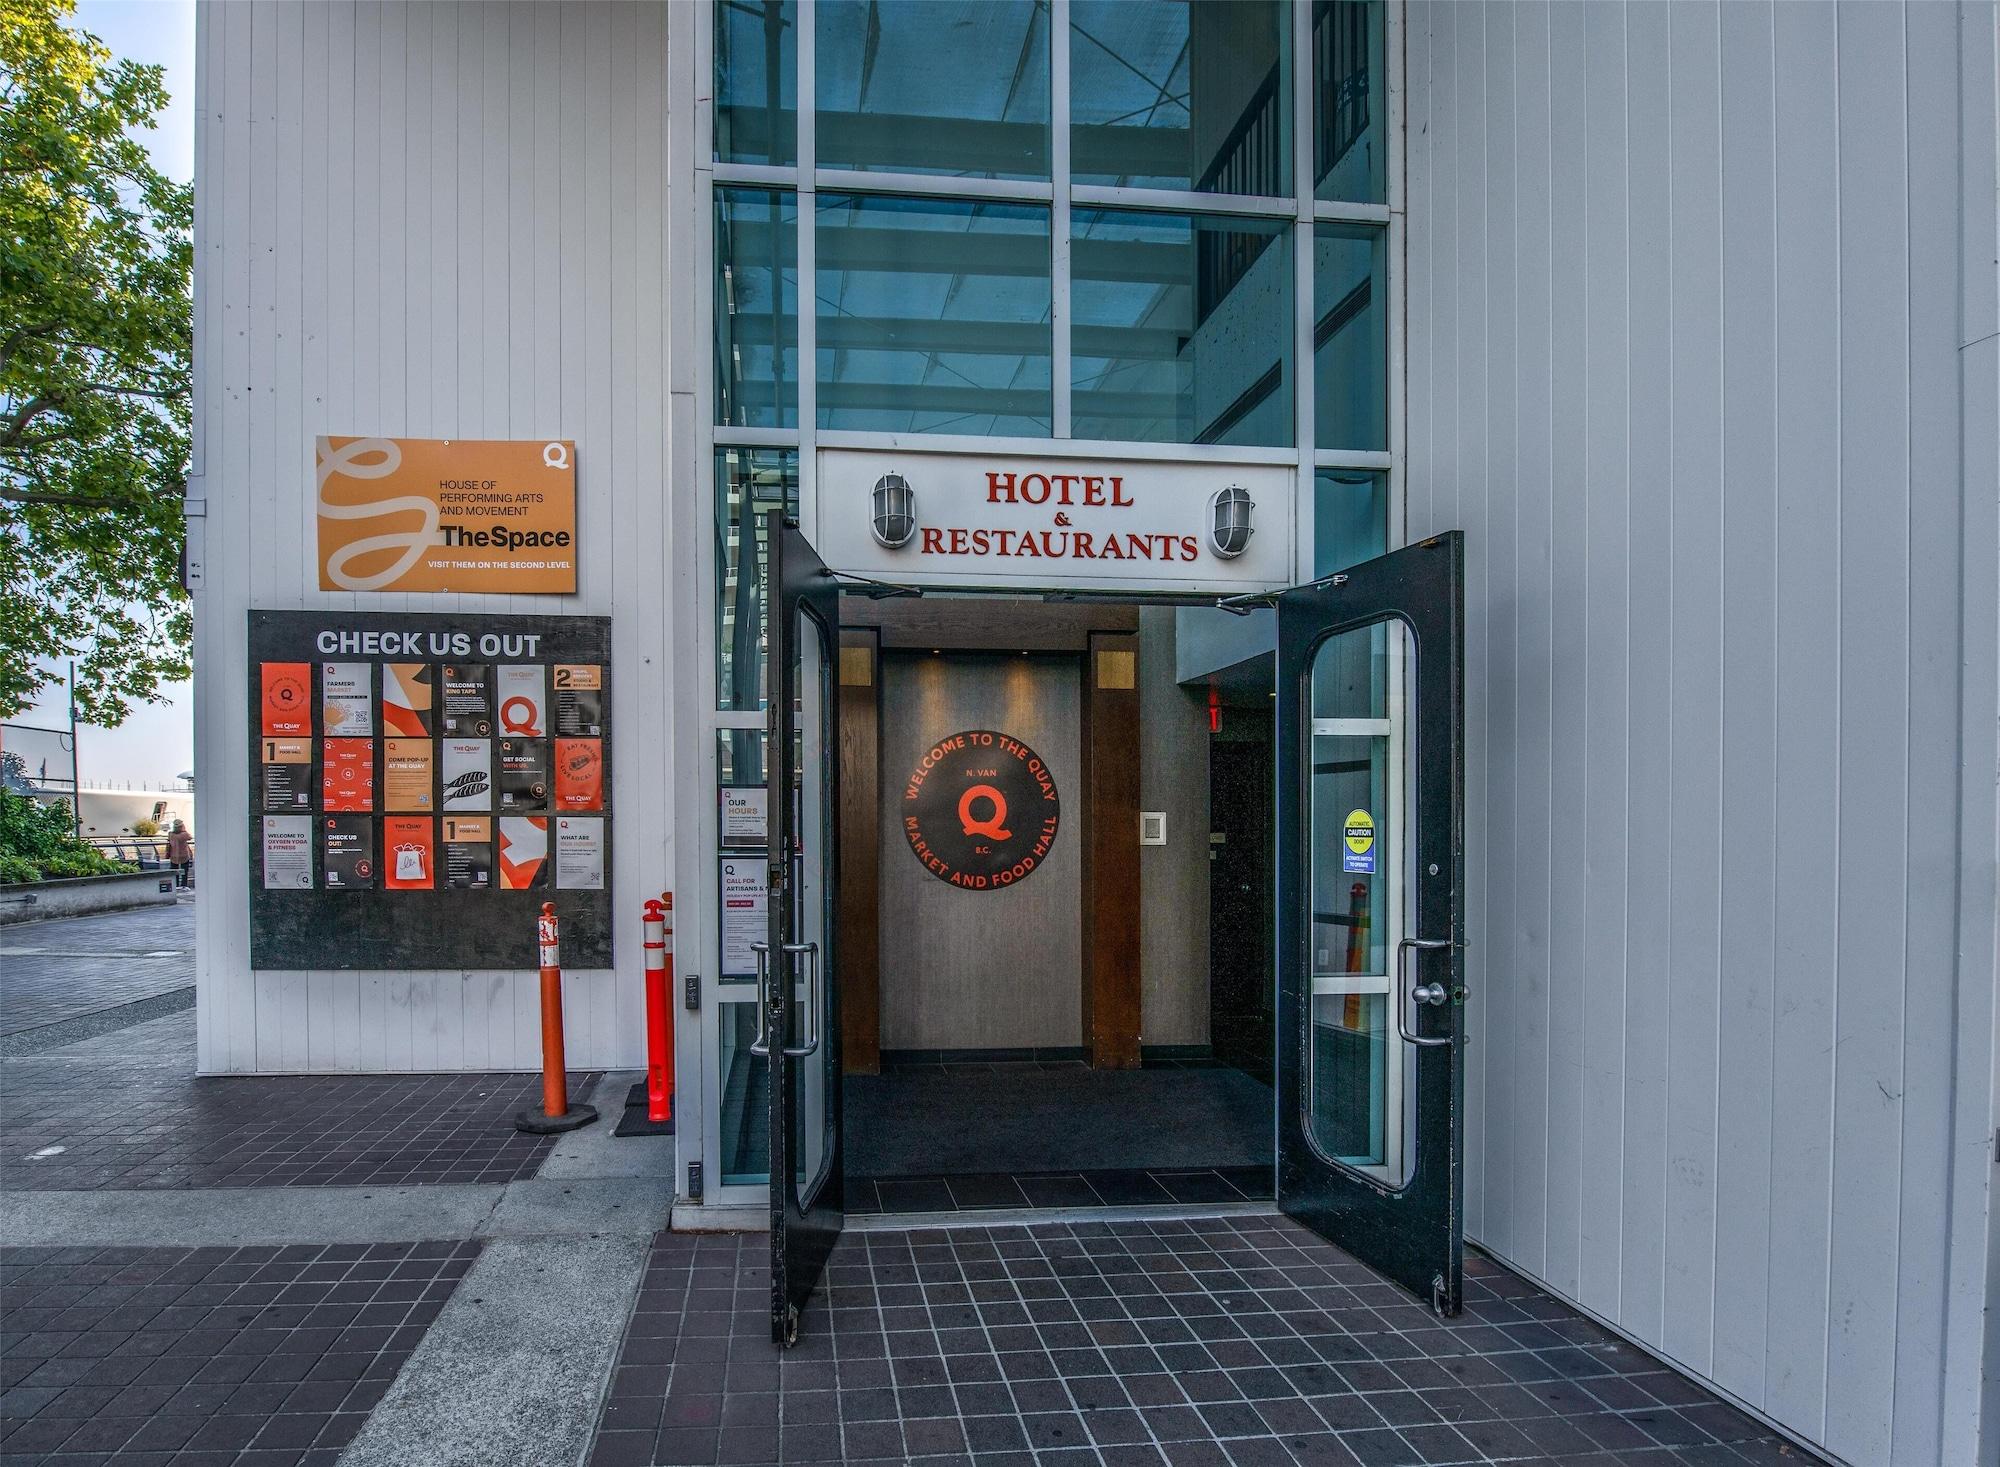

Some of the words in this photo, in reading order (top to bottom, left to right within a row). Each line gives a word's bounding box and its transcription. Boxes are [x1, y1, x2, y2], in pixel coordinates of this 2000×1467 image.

[543, 442, 569, 470] Q
[440, 480, 478, 490] HOUSE
[481, 480, 497, 490] OF
[985, 472, 1134, 507] HOTEL
[440, 493, 513, 503] PERFORMING
[515, 493, 544, 503] ARTS
[440, 506, 463, 516] AND
[466, 506, 528, 516] MOVEMENT
[1053, 511, 1072, 527] &
[440, 525, 570, 551] TheSpace
[920, 527, 1198, 562] RESTAURANTS
[428, 561, 450, 569] VISIT
[452, 561, 475, 569] THEM
[478, 561, 491, 569] ON
[492, 561, 509, 569] THE
[511, 561, 545, 569] SECOND
[546, 561, 570, 569] LEVEL
[316, 630, 423, 656] CHECK
[429, 632, 471, 656] US
[479, 633, 541, 657] OUT
[327, 666, 335, 675] Q
[445, 667, 455, 677] Q
[557, 668, 571, 687] 2
[281, 688, 293, 701] Q
[501, 695, 542, 737] Q
[389, 742, 396, 750] Q
[503, 742, 511, 751] Q
[567, 743, 578, 751] EAT
[266, 742, 275, 761] 1
[906, 736, 965, 800] WELCOME
[970, 733, 993, 746] TO
[999, 736, 1029, 761] THE
[1027, 759, 1056, 801] QUAY
[571, 773, 592, 781] LOCAL
[966, 769, 976, 777] N.
[978, 769, 997, 777] VAN
[729, 807, 758, 815] HOURS
[958, 784, 1013, 841] Q
[268, 819, 276, 827] Q
[327, 819, 336, 829] Q
[447, 821, 455, 840] 1
[905, 816, 949, 875] MARKET
[950, 872, 987, 888] AND
[992, 857, 1034, 886] FOOD
[1033, 816, 1056, 857] HALL
[975, 846, 992, 854] B.C.
[725, 865, 735, 875] Q
